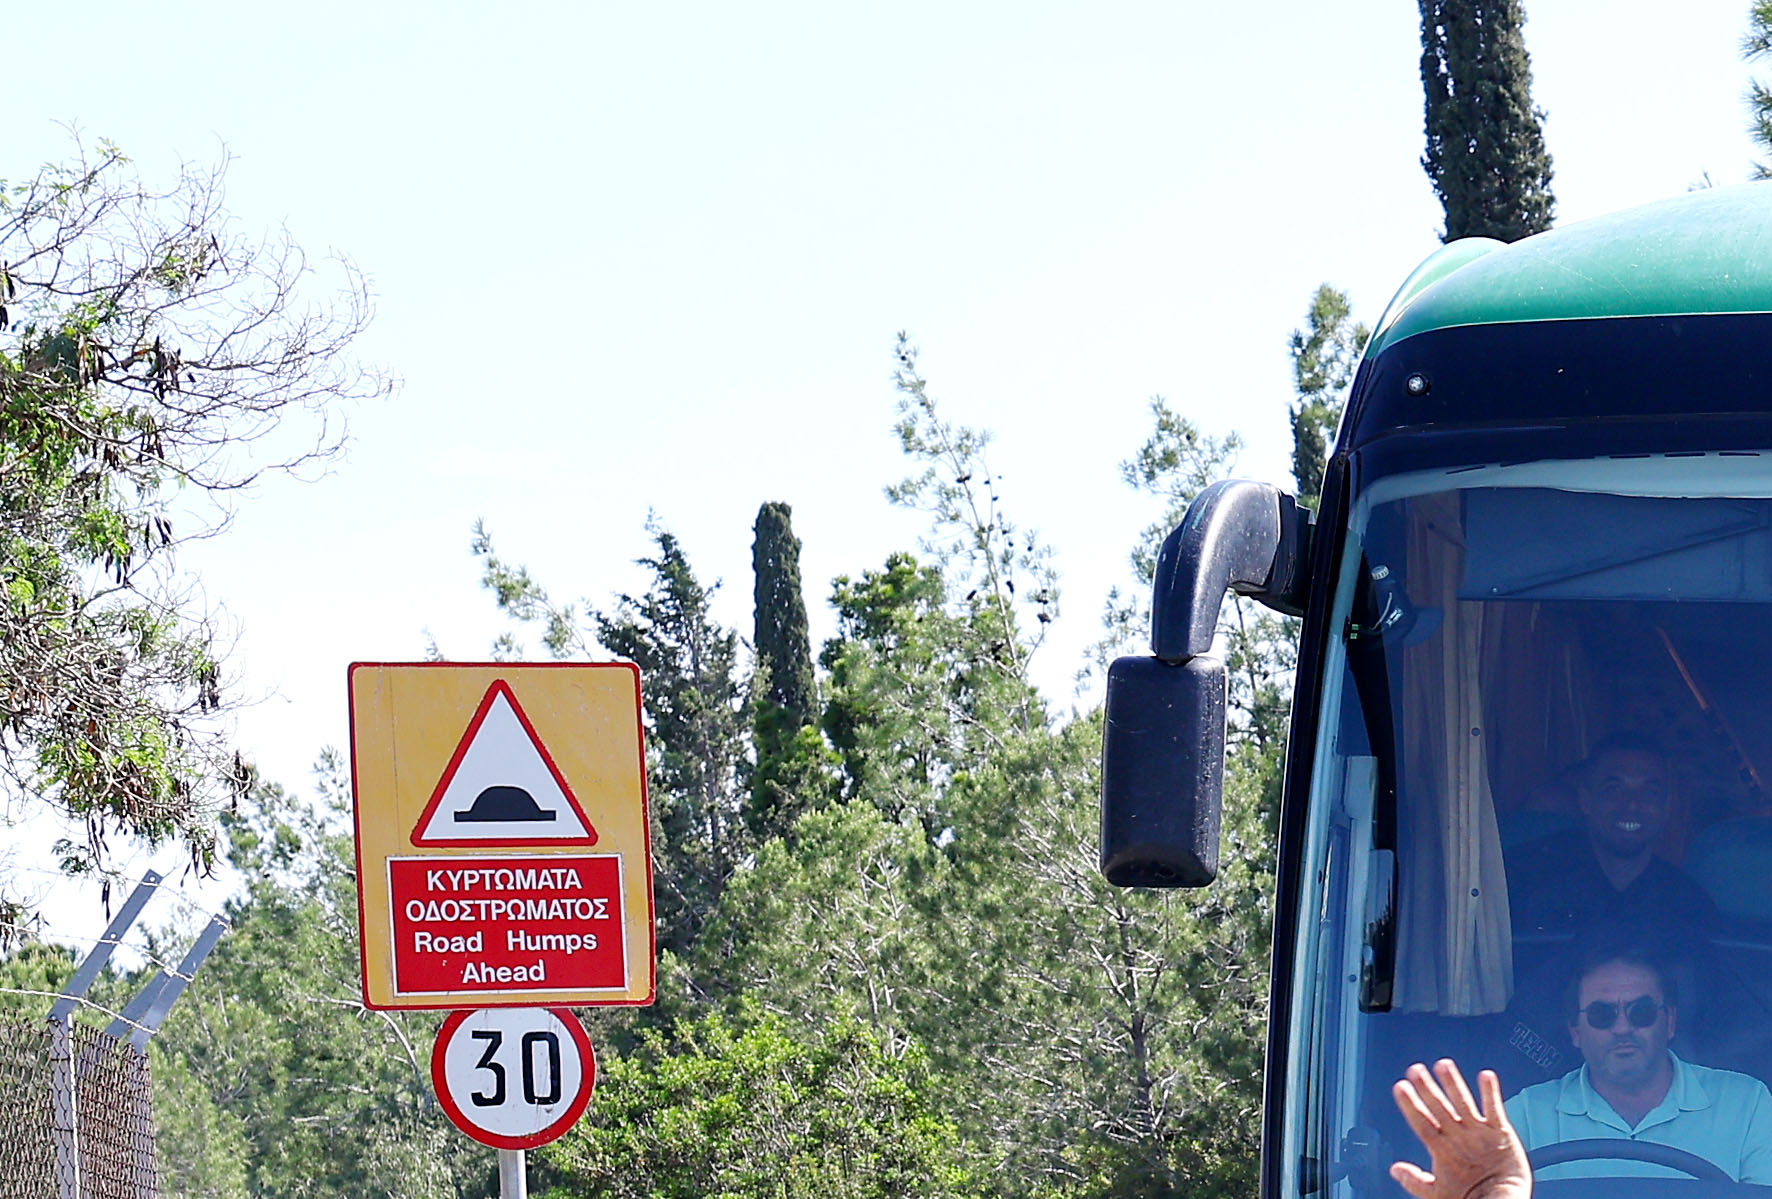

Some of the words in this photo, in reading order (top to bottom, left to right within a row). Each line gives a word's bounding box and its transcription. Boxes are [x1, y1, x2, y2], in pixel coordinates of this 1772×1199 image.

[426, 868, 581, 891] ΚΥΡΤΩΜΑΤΑ
[405, 898, 608, 922] ΟΔΟΣΤΡΩΜΑΤΟΣ
[414, 930, 483, 954] Road
[507, 930, 597, 955] Humps
[462, 958, 546, 984] Ahead
[470, 1030, 562, 1108] 30
